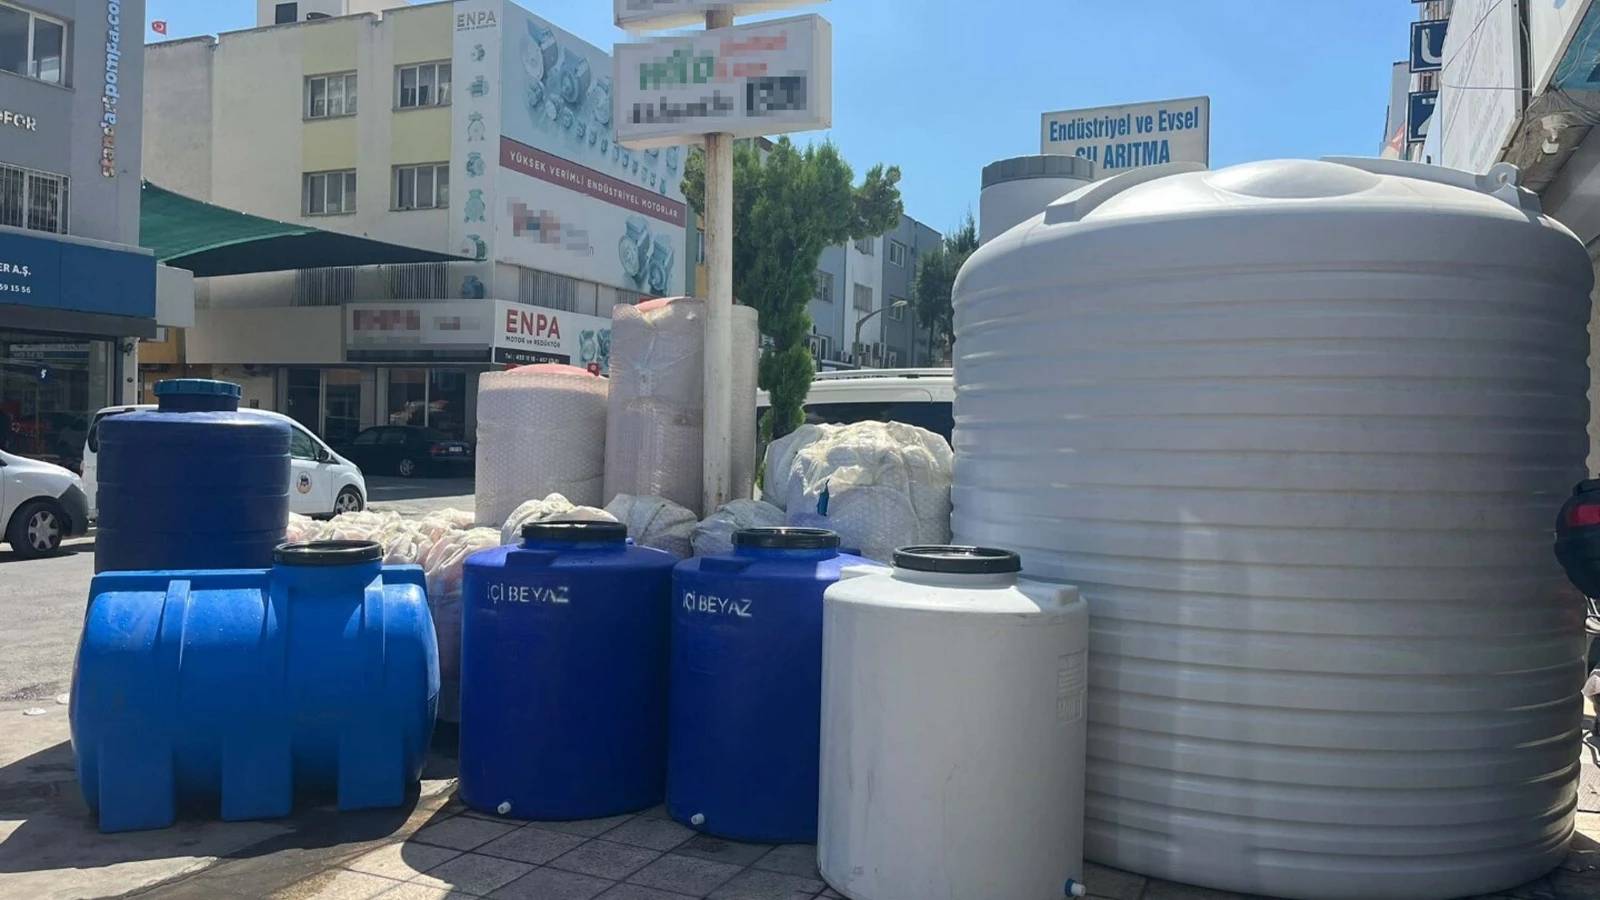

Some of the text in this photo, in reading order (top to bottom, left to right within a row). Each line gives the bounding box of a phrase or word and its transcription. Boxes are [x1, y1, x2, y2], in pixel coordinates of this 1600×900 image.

[457, 11, 497, 27] ENPA
[1049, 106, 1199, 141] Endüstriyel ve Evsel
[1103, 139, 1171, 169] ARITMA
[510, 151, 679, 218] YÜKSEK VERİMLİ ENDÜSTRİYEL MOTORLAR
[12, 264, 31, 278] A.Ş.
[11, 284, 20, 292] 15
[506, 308, 561, 340] ENPA
[505, 335, 526, 345] MOTOR
[508, 586, 569, 603] BEYAZ
[699, 595, 752, 617] BEYAZ
